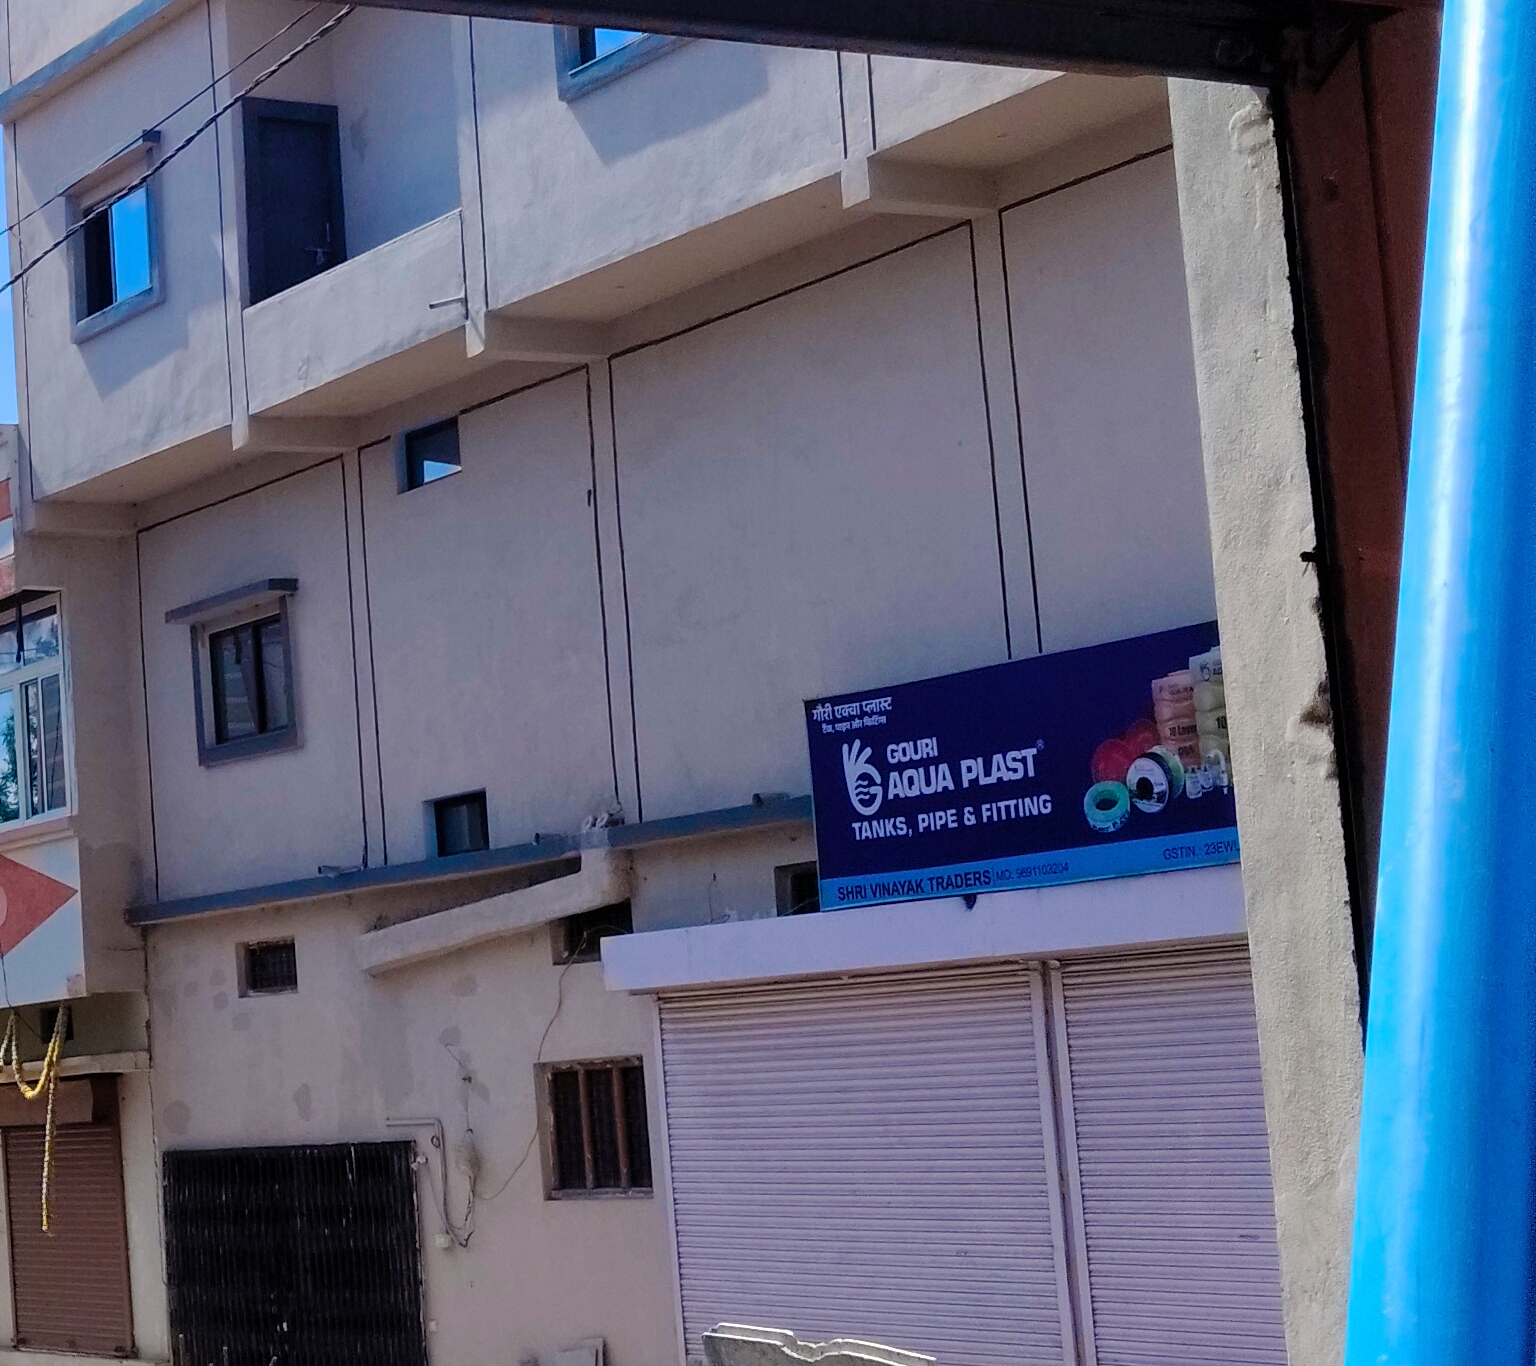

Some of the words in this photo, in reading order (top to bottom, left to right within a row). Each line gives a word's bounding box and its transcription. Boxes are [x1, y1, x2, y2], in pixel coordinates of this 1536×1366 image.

[887, 737, 939, 764] GOURI
[887, 763, 955, 800] AQUA
[960, 747, 1038, 788] PLAST
[852, 815, 913, 841] TANKS,
[917, 809, 959, 833] PIPE
[963, 806, 977, 826] &
[981, 794, 1052, 823] FITTING
[837, 884, 867, 902] SHRI
[869, 878, 925, 898] VINAYAK
[928, 869, 992, 893] TRADERS
